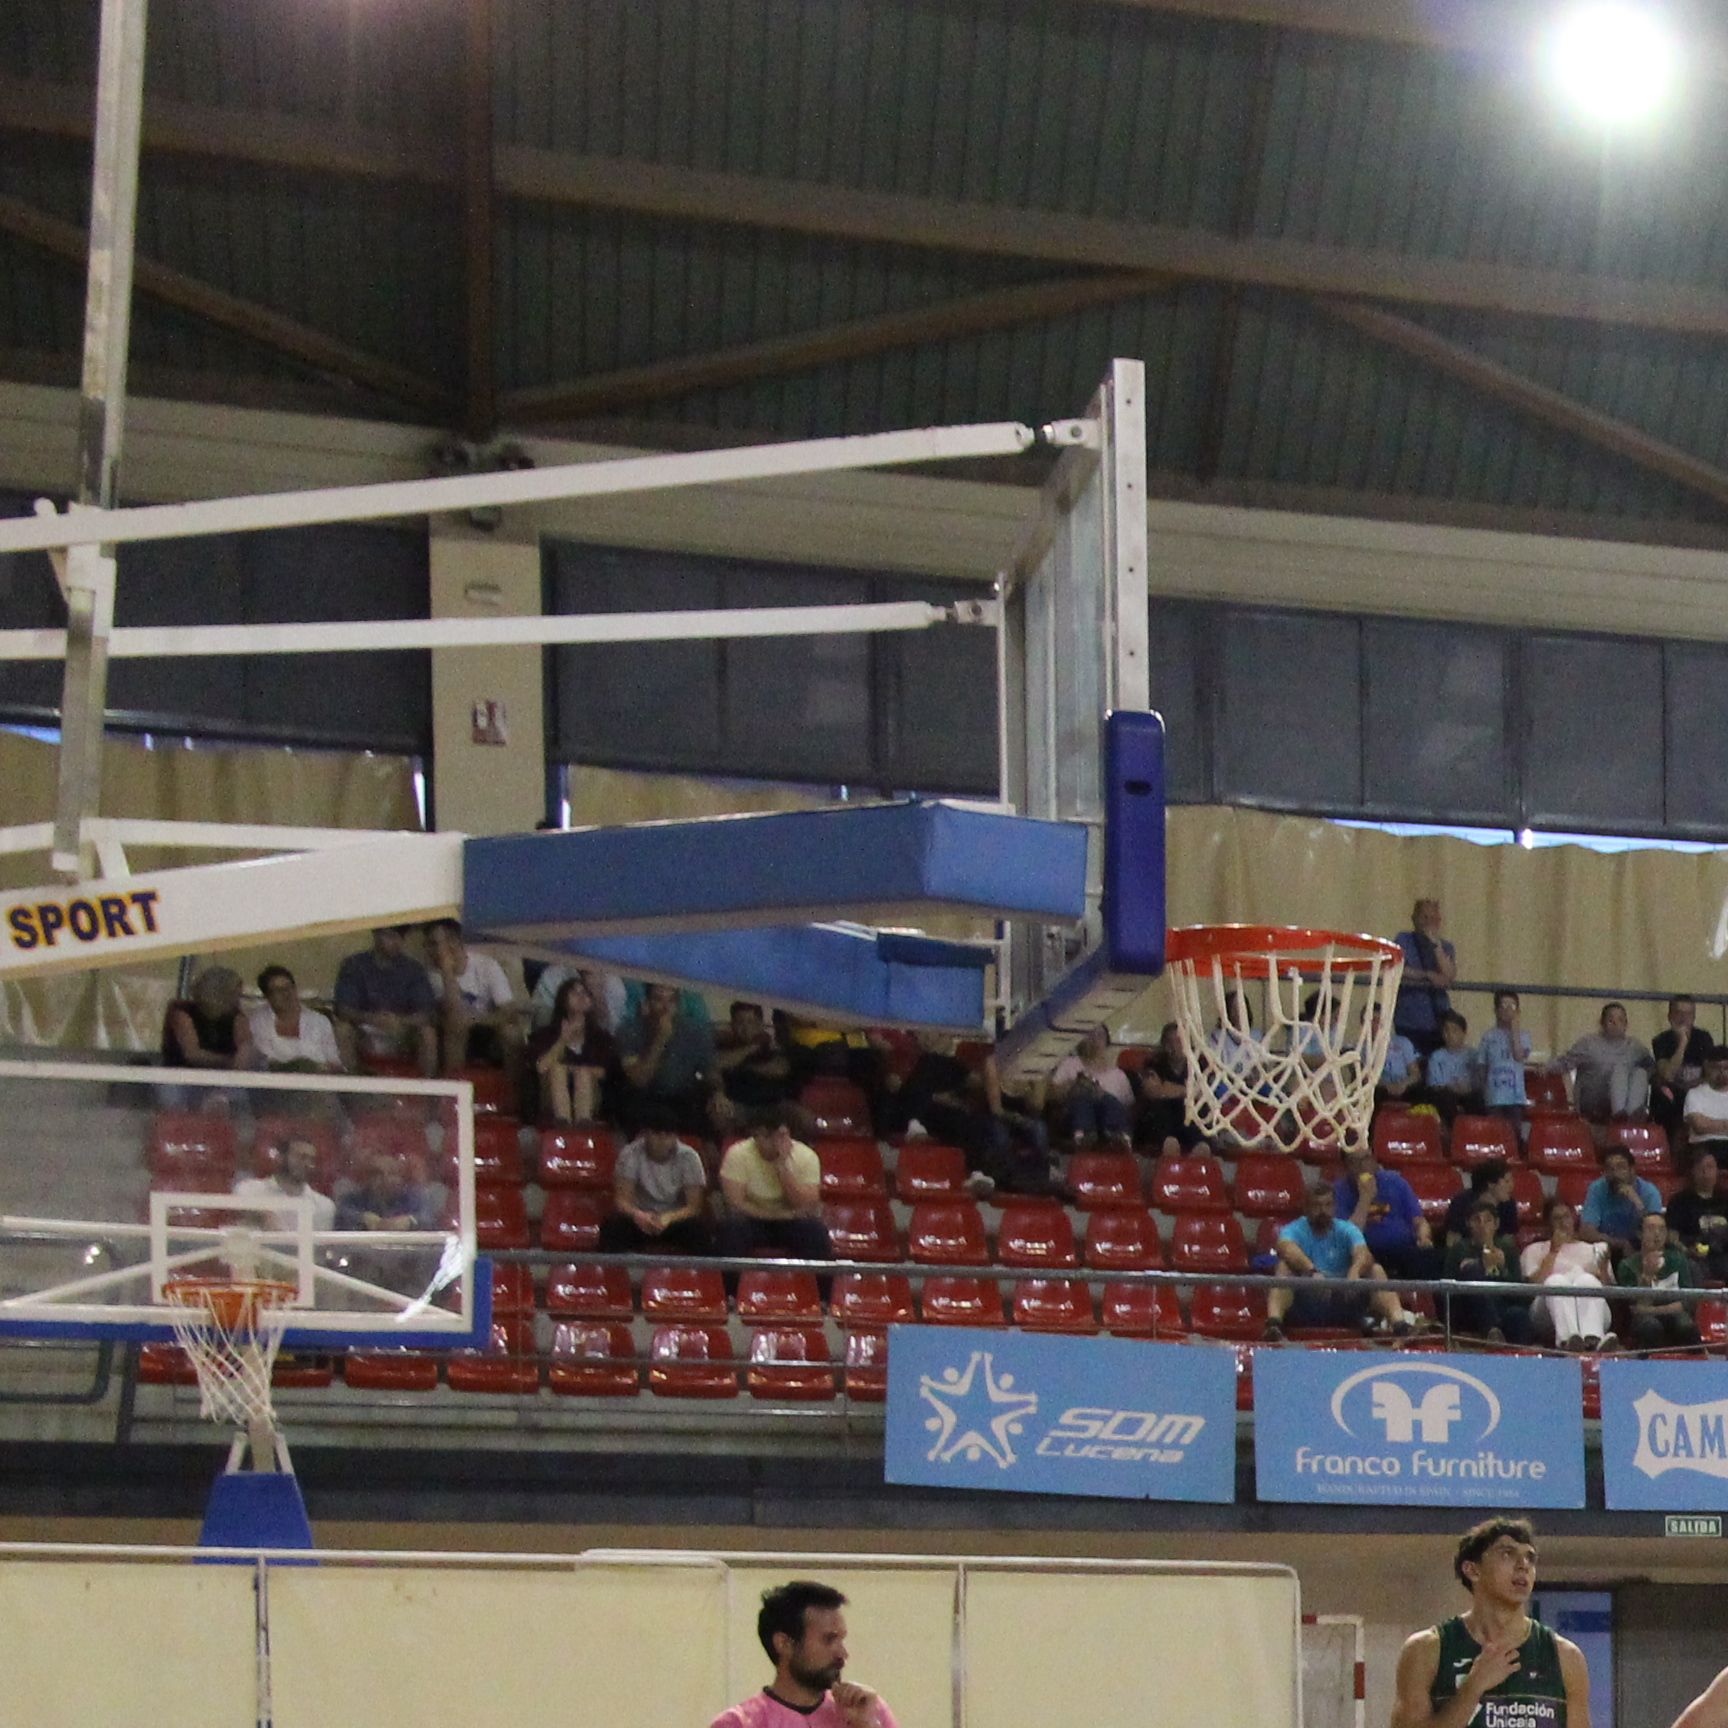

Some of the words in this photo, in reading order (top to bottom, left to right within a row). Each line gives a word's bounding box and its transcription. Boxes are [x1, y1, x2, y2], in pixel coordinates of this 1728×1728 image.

[7, 890, 159, 949] SPORT
[1049, 1408, 1206, 1444] SDM
[1035, 1437, 1185, 1463] Lucena
[1296, 1447, 1401, 1475] Franco
[1670, 1519, 1718, 1534] SALIDA
[1486, 1702, 1555, 1719] Fundación
